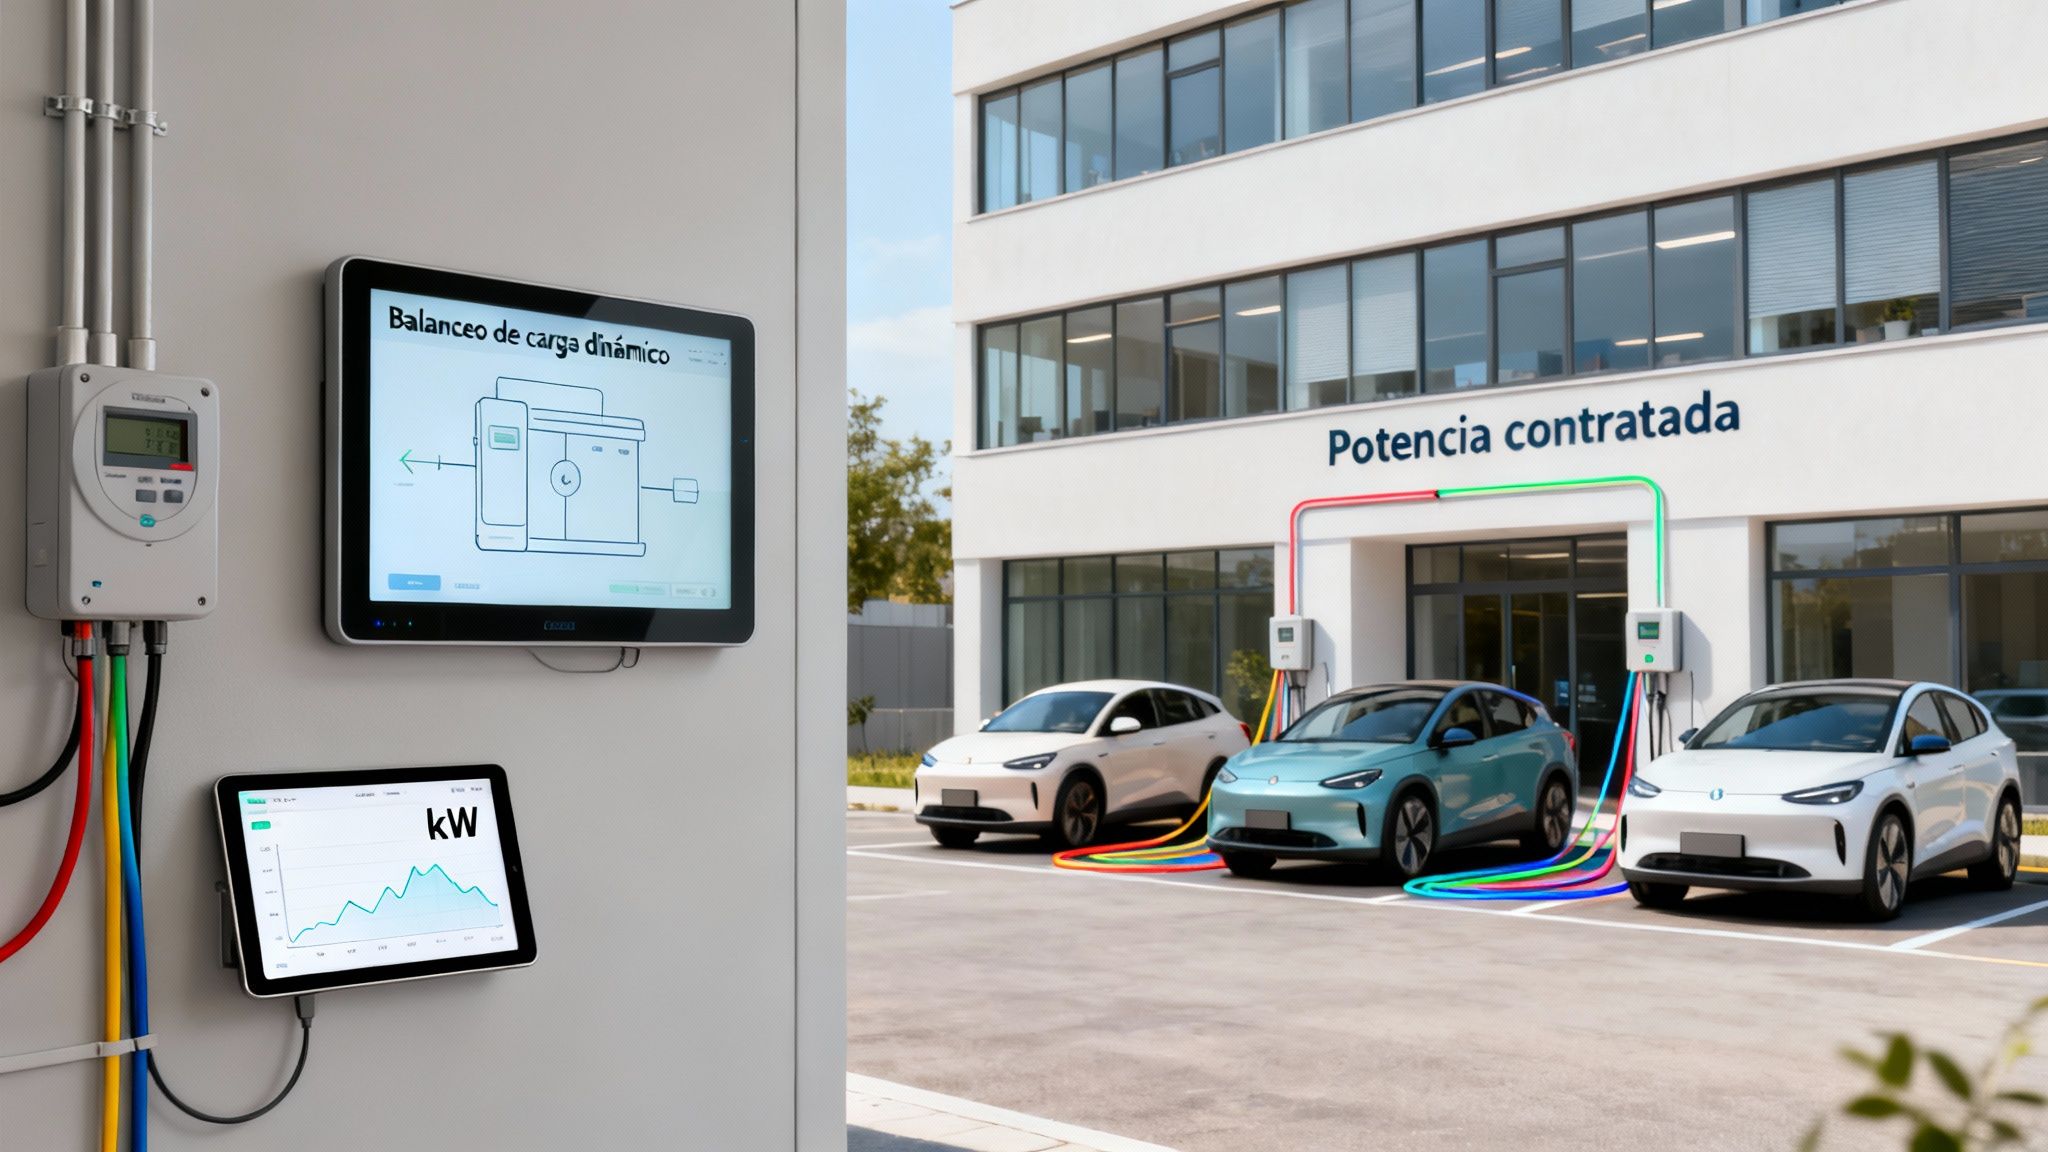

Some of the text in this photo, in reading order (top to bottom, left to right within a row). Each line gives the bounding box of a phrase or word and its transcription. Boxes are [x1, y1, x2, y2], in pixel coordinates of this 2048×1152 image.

[388, 306, 488, 341] Balanceo
[493, 319, 521, 346] de
[526, 330, 580, 359] carga
[584, 331, 671, 366] dinámico
[1328, 389, 1741, 466] Potencia contratada
[426, 806, 478, 840] kW
